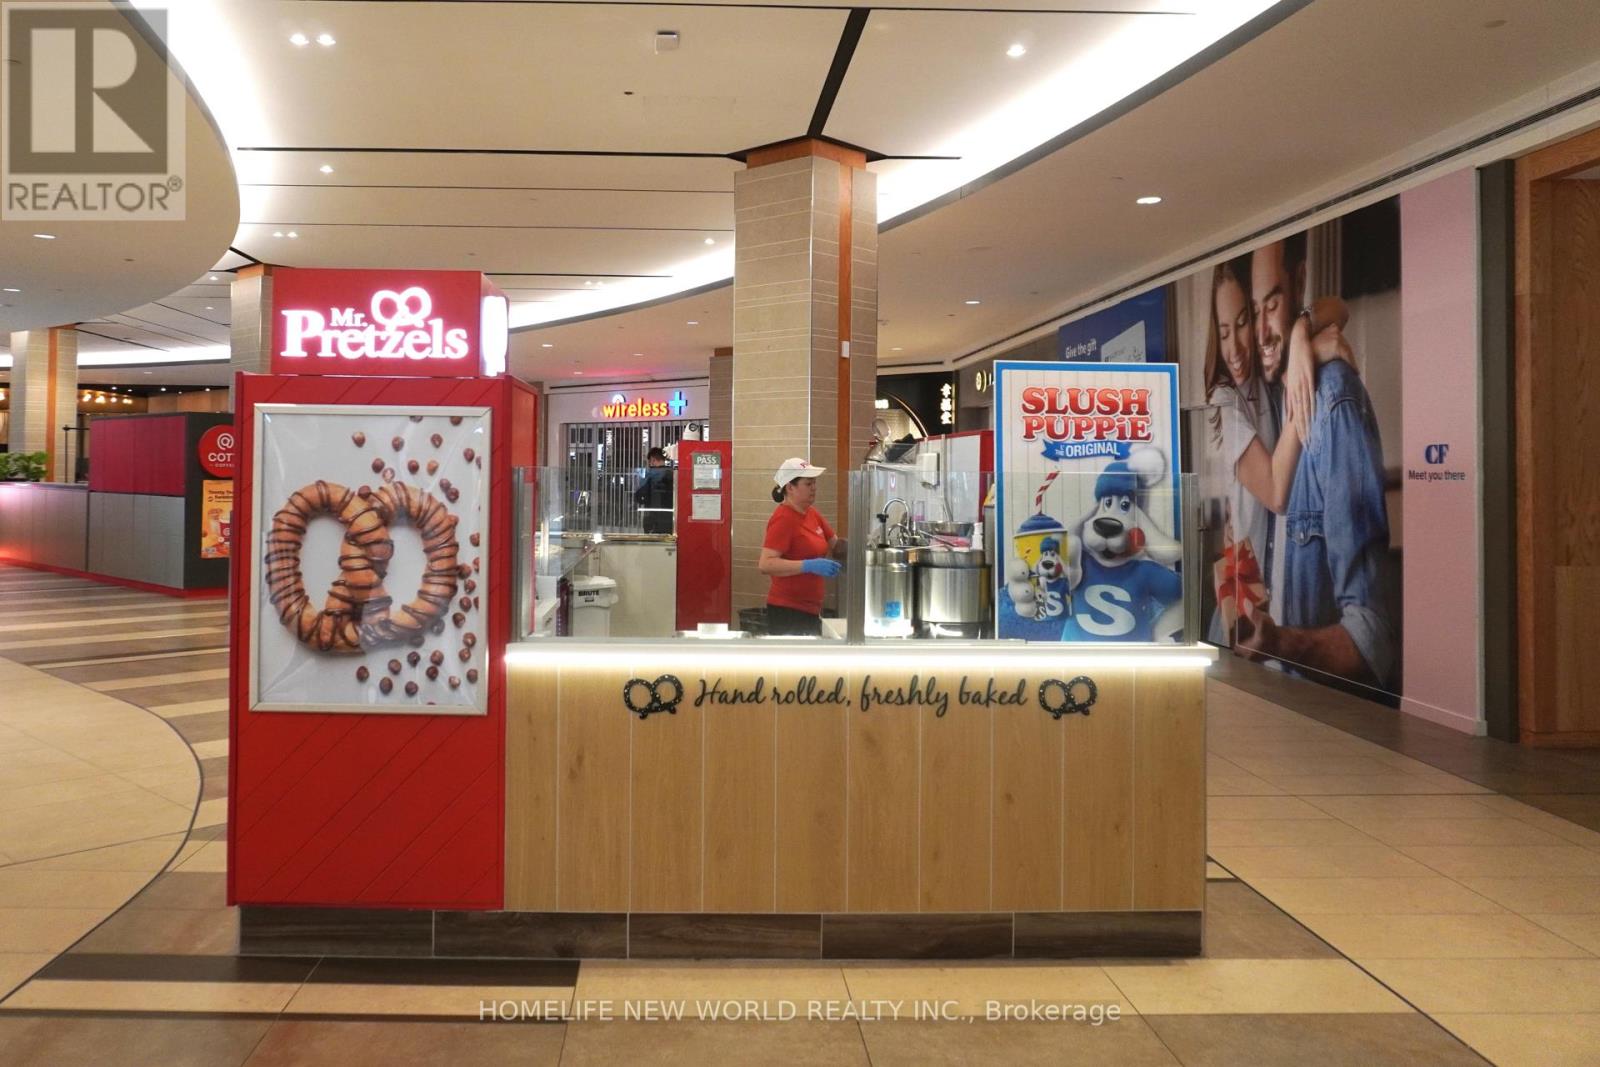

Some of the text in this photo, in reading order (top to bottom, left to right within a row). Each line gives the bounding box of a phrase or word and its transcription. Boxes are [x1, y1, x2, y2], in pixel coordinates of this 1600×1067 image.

[330, 308, 368, 327] Mr.
[280, 309, 469, 360] Pretzels
[1065, 346, 1077, 359] Give
[1077, 342, 1087, 355] the
[1021, 387, 1151, 416] SLUSH
[208, 453, 235, 462] COT
[1065, 442, 1120, 457] ORIGINAL
[1425, 444, 1449, 464] CF
[697, 456, 717, 465] PASS
[1408, 470, 1465, 482] Meet you there
[1075, 584, 1136, 636] S
[694, 674, 1028, 718] Hand rolled, freshly baked
